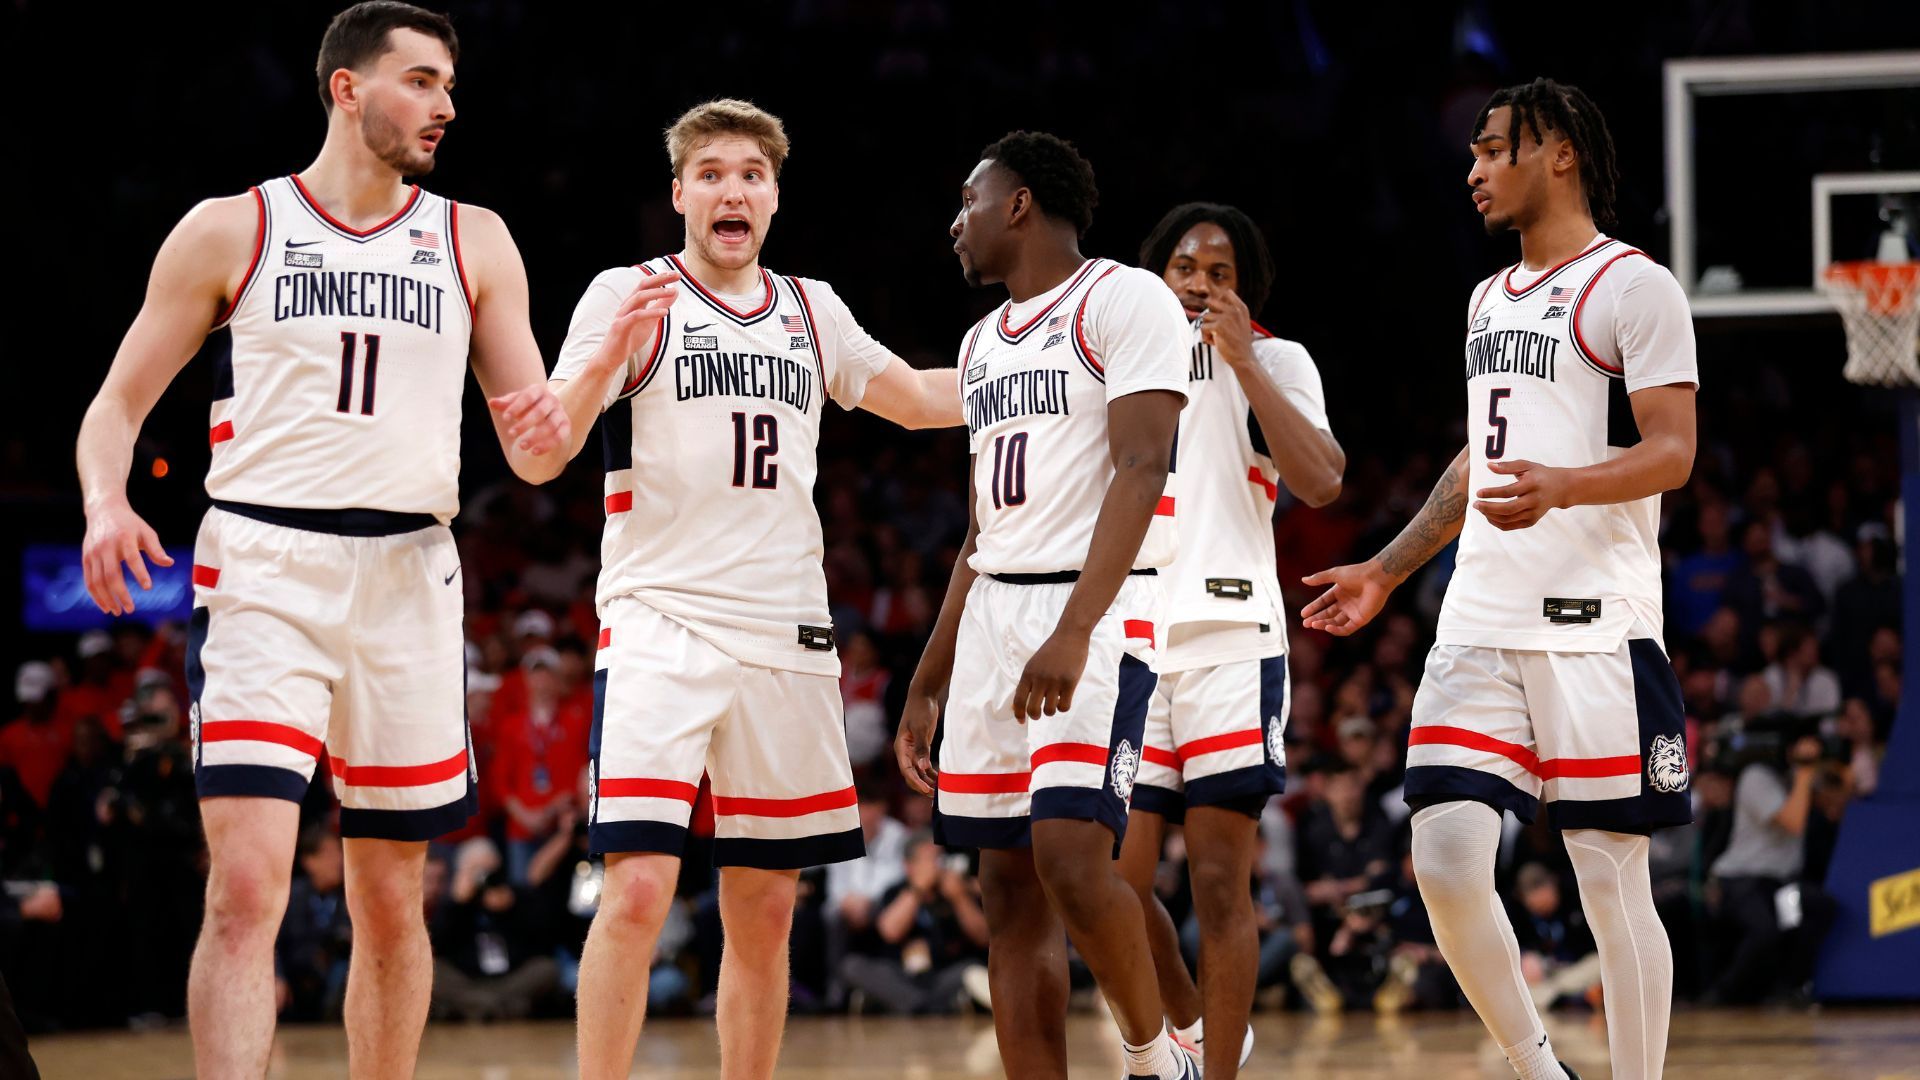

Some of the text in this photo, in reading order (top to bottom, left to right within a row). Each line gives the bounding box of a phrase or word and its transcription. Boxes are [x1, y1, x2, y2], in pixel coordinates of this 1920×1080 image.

[286, 259, 321, 267] CHANGE
[412, 256, 442, 264] EAST
[275, 271, 445, 334] CONNECTICUT
[336, 331, 381, 416] 11
[675, 352, 812, 415] CONNECTICUT
[1467, 330, 1560, 383] CONNECTICUT
[967, 369, 1069, 434] CONNECTICUT
[1485, 388, 1511, 460] 5
[731, 411, 779, 490] 12
[992, 431, 1029, 511] 10
[1585, 604, 1596, 612] 46
